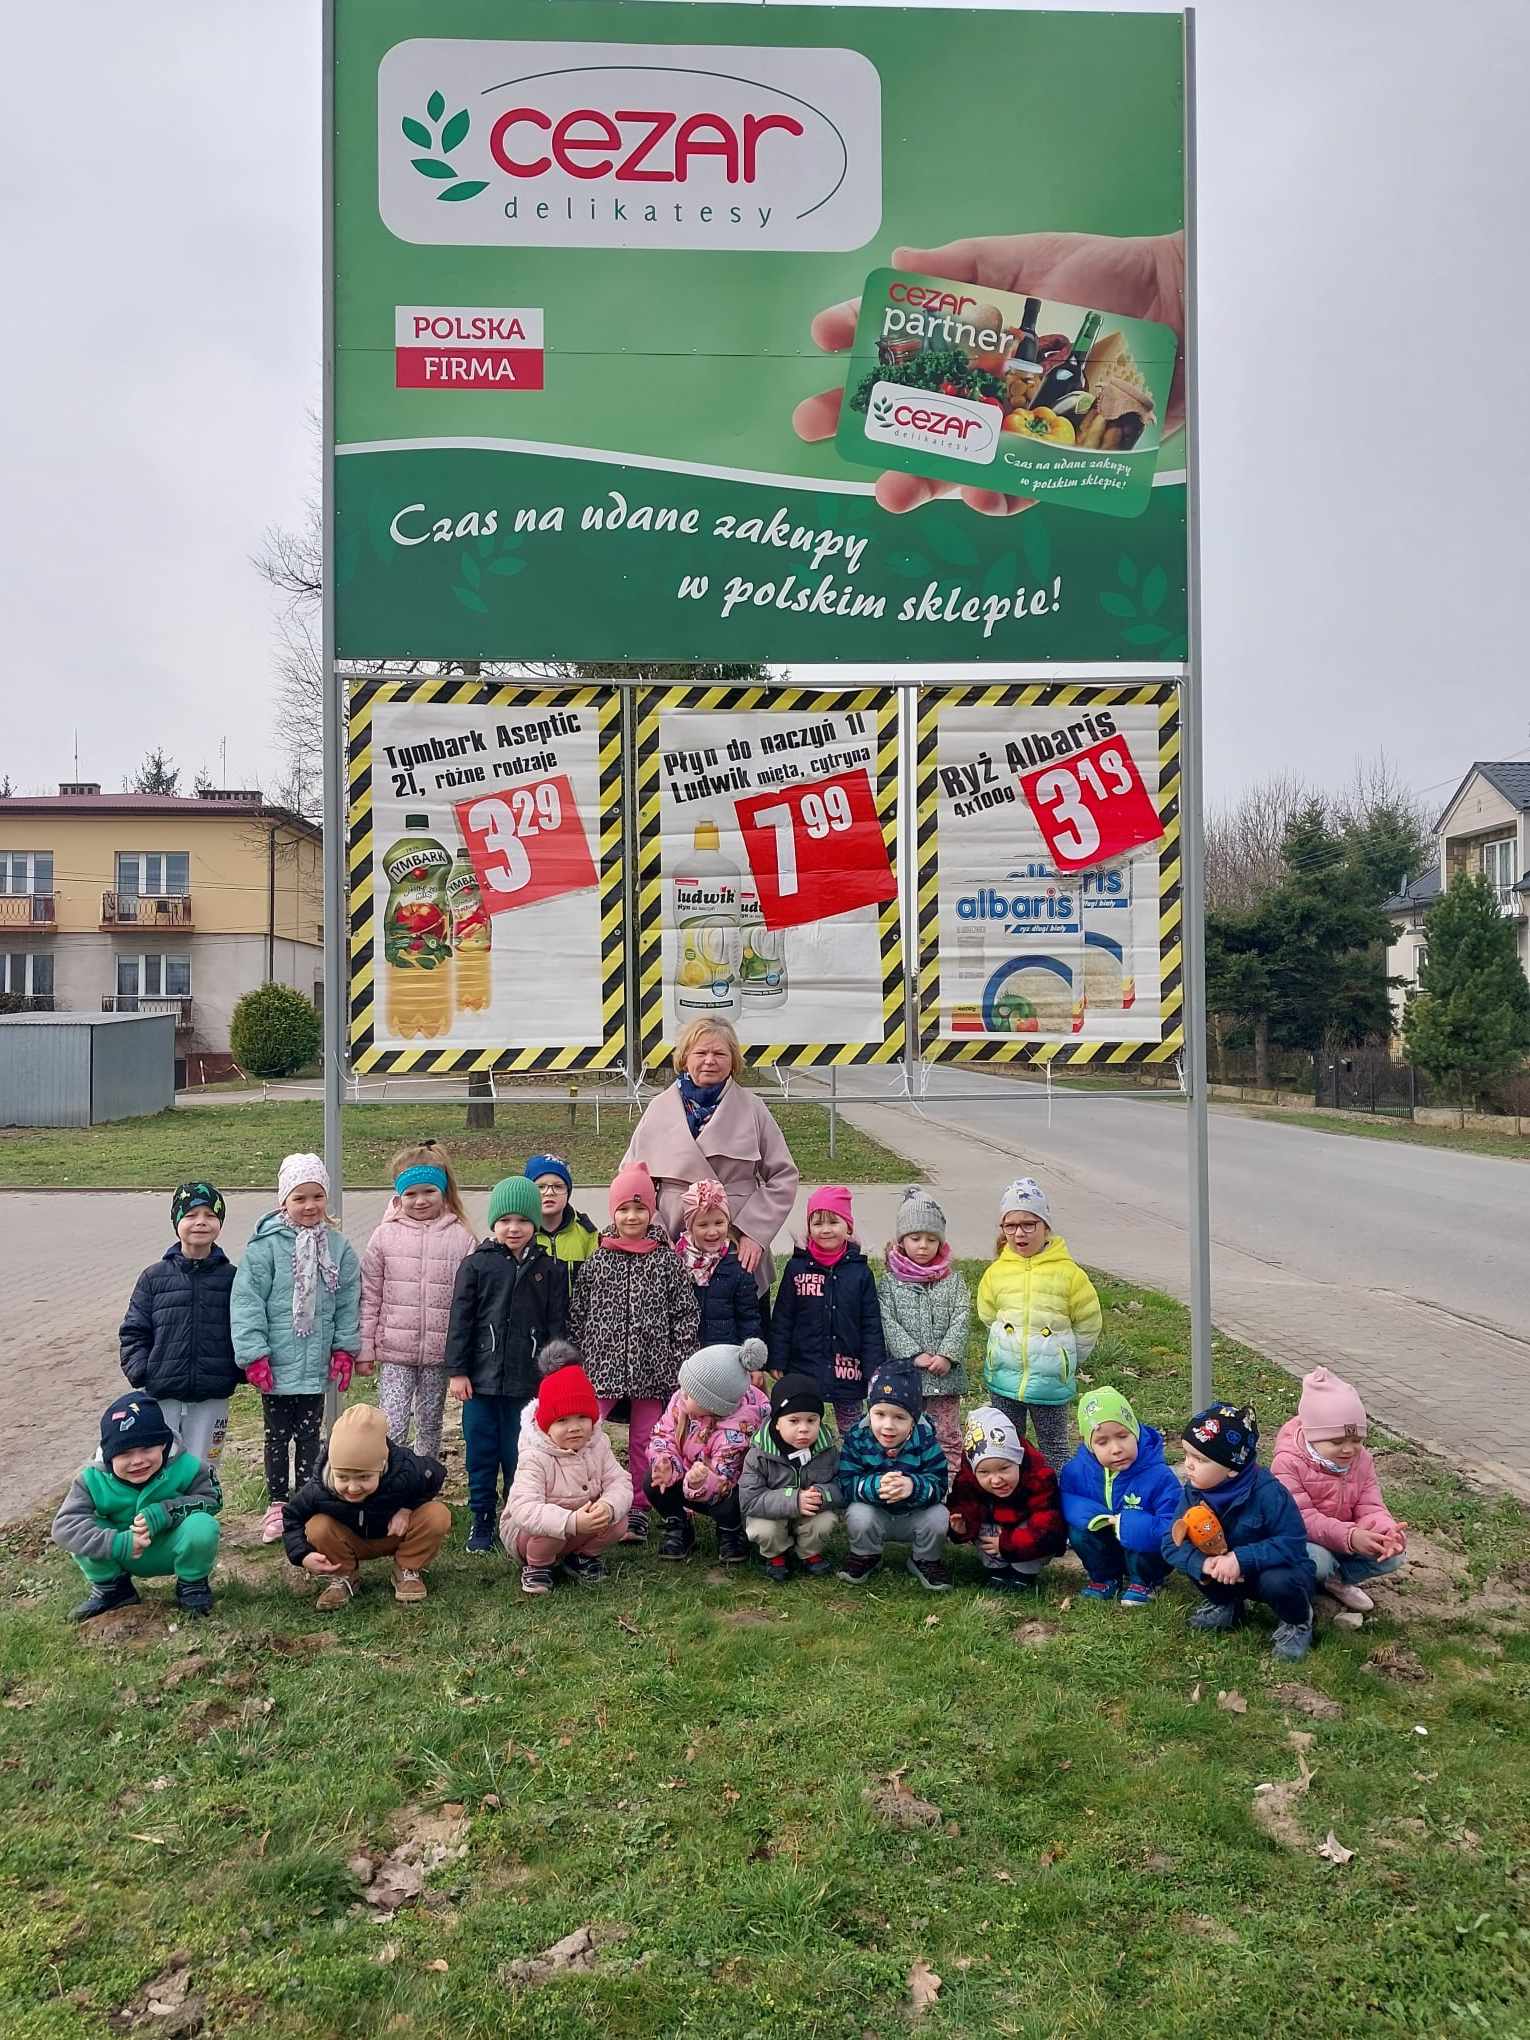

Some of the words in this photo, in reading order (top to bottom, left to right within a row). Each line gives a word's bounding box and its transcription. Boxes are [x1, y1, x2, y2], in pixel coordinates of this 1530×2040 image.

[504, 197, 772, 229] delikatesy
[413, 316, 526, 341] POLSKA
[883, 307, 1014, 353] partner
[424, 357, 515, 381] FIRMA
[1004, 452, 1032, 469] Czas
[1036, 462, 1050, 470] na
[1054, 458, 1086, 469] udane
[1089, 458, 1132, 477] zakupy
[1032, 477, 1078, 492] polskim
[389, 503, 500, 548] Czas
[514, 504, 564, 534] na
[580, 492, 701, 535] udane
[713, 506, 869, 575] zakupy
[677, 573, 711, 600] w
[721, 571, 887, 619] polskim
[898, 577, 1063, 639] sklepie!
[383, 730, 487, 772] Tymbark
[496, 712, 581, 749] Aseptic
[664, 748, 719, 776] Płyn
[726, 739, 752, 761] do
[760, 718, 837, 755] naczyń
[939, 751, 999, 798] Ryż
[1005, 711, 1117, 774] Albaris
[435, 767, 486, 789] różne
[493, 751, 557, 778] rodzaje
[671, 767, 751, 804] Ludwik
[810, 747, 870, 774] cytryna
[953, 785, 1016, 818] 4x100g
[391, 851, 446, 878] TYMBARK
[677, 886, 735, 904] ludwik
[956, 888, 1074, 920] albaris
